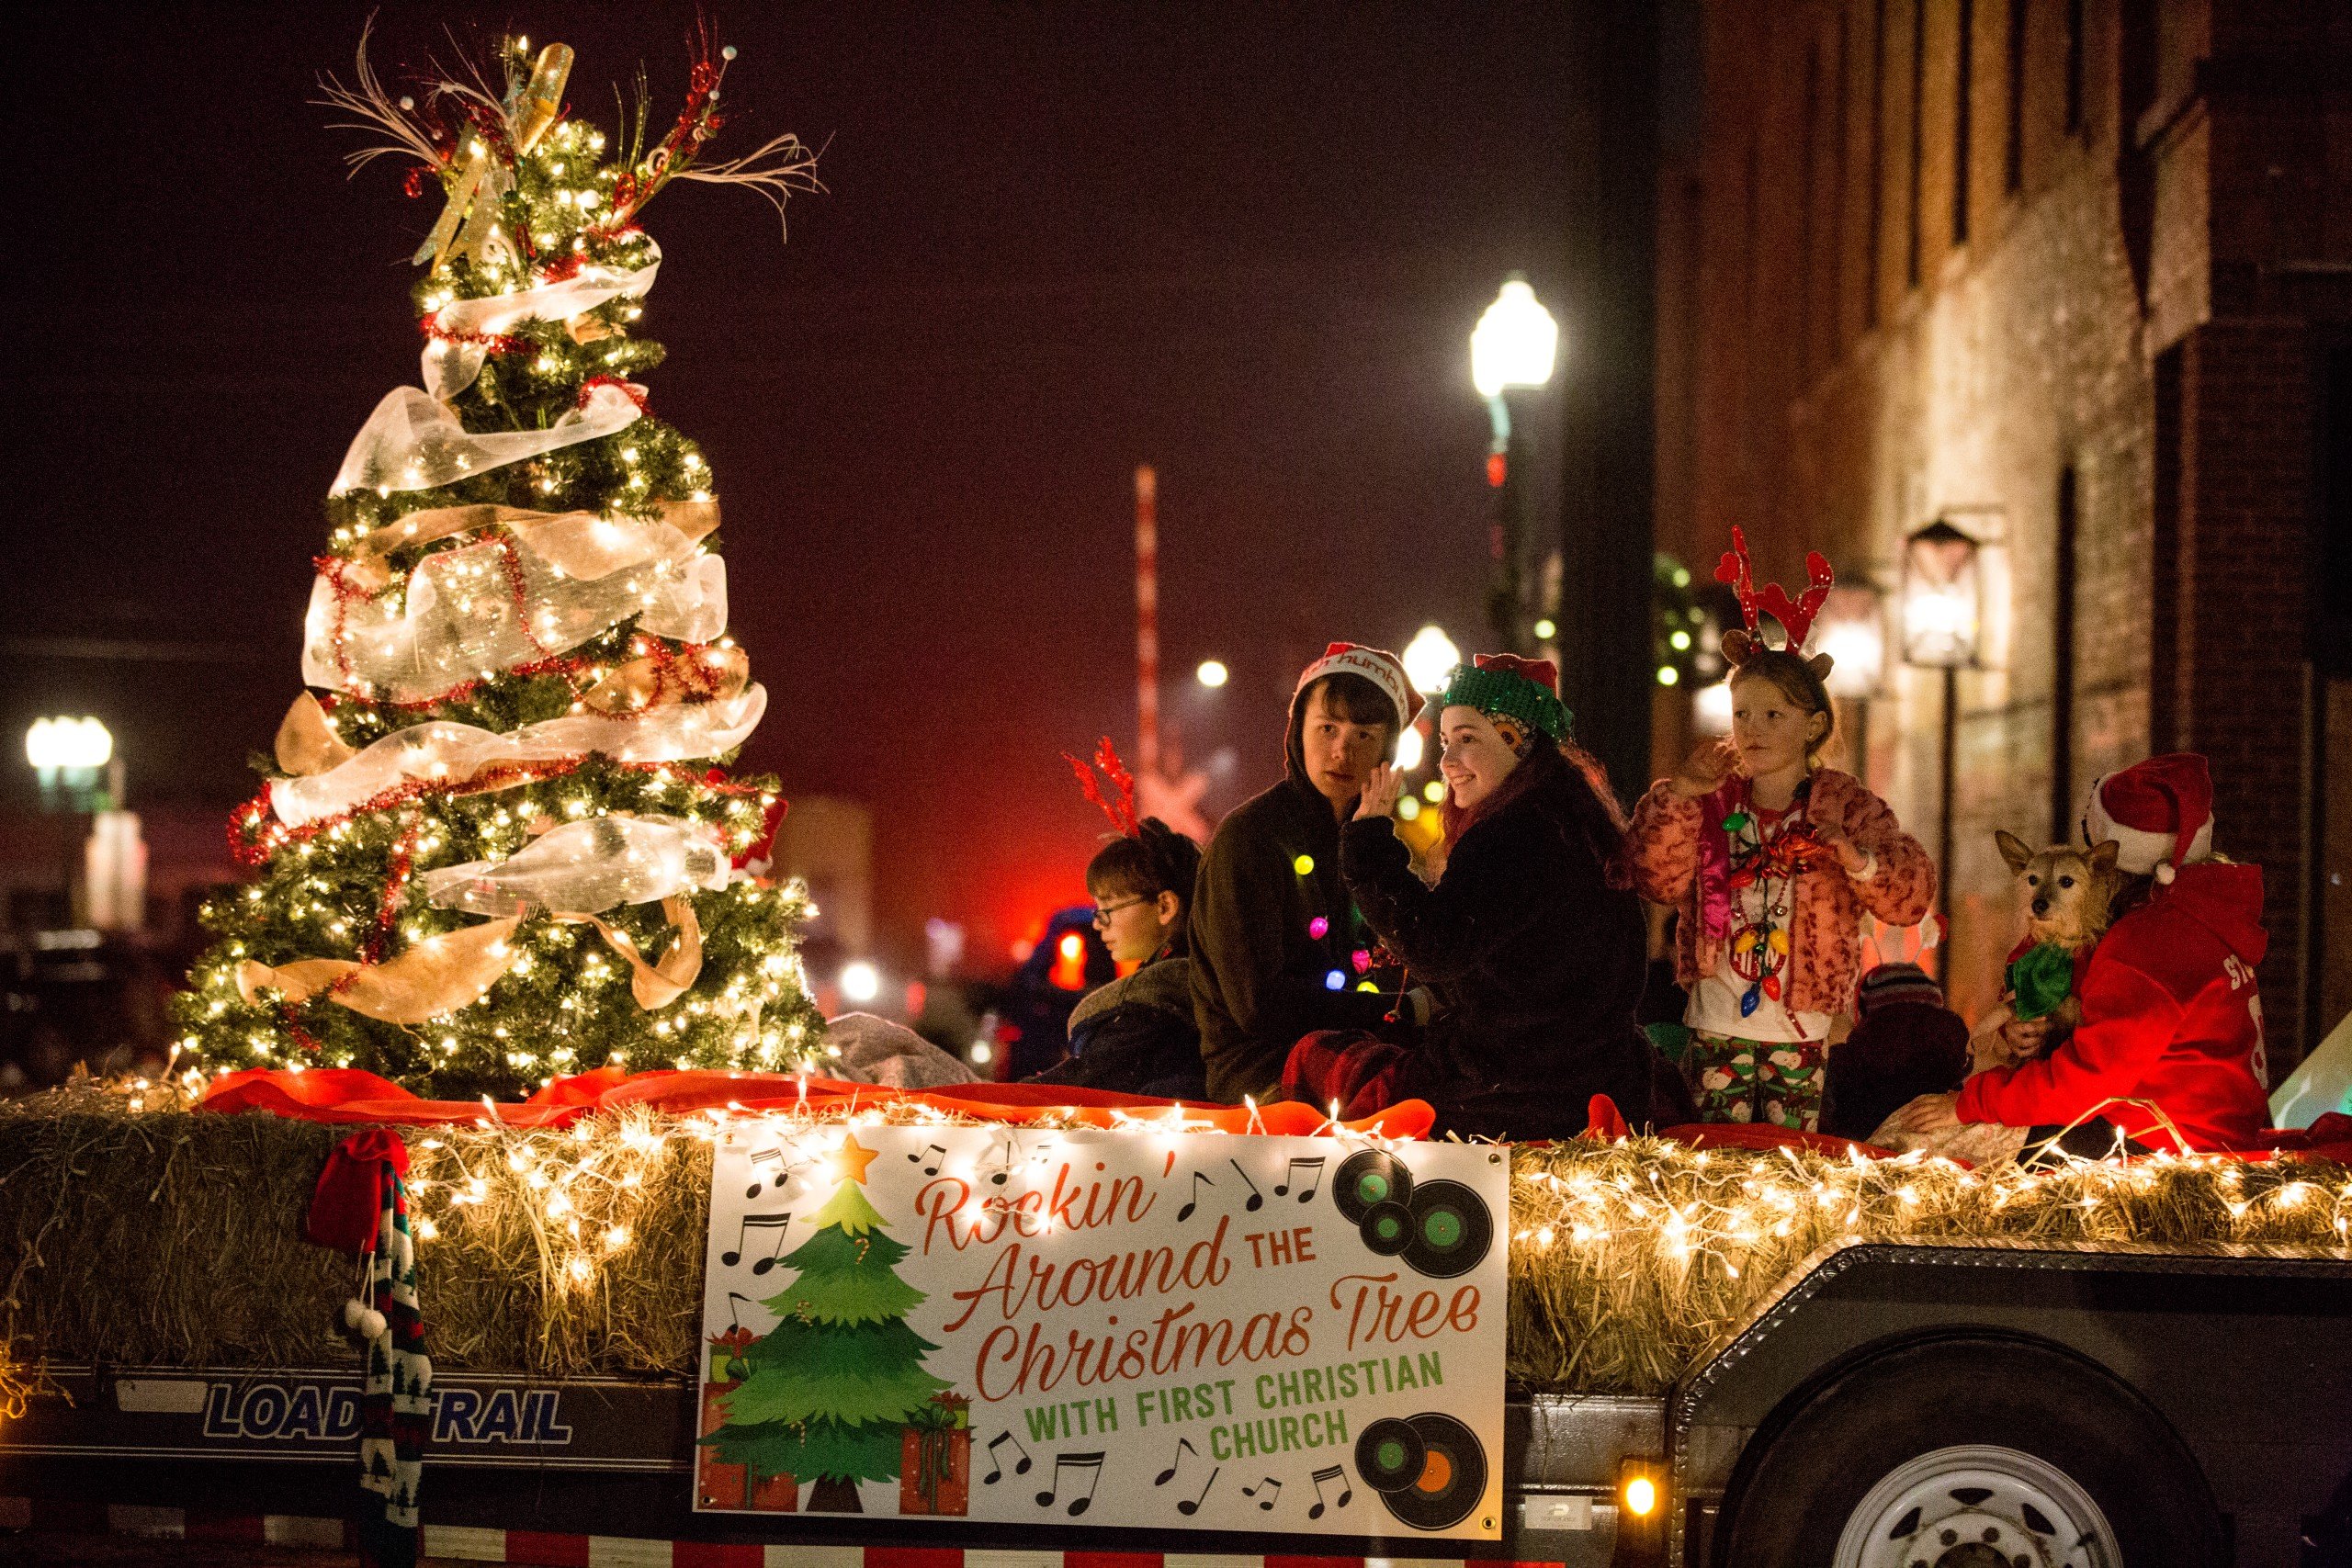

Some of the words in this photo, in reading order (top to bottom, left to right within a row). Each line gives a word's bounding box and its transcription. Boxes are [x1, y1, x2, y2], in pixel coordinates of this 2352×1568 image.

[914, 1150, 1176, 1256] Rockin'
[943, 1214, 1231, 1333] Around
[1244, 1226, 1317, 1269] THE
[976, 1302, 1313, 1403] Christmas
[1330, 1272, 1481, 1352] Tree
[203, 1383, 365, 1439] LOAD
[427, 1387, 572, 1445] RAIL
[1024, 1396, 1119, 1443] WITH
[1136, 1380, 1236, 1427] FIRST
[1255, 1350, 1444, 1410] CHRISTIAN
[1209, 1409, 1349, 1461] CHURCH
